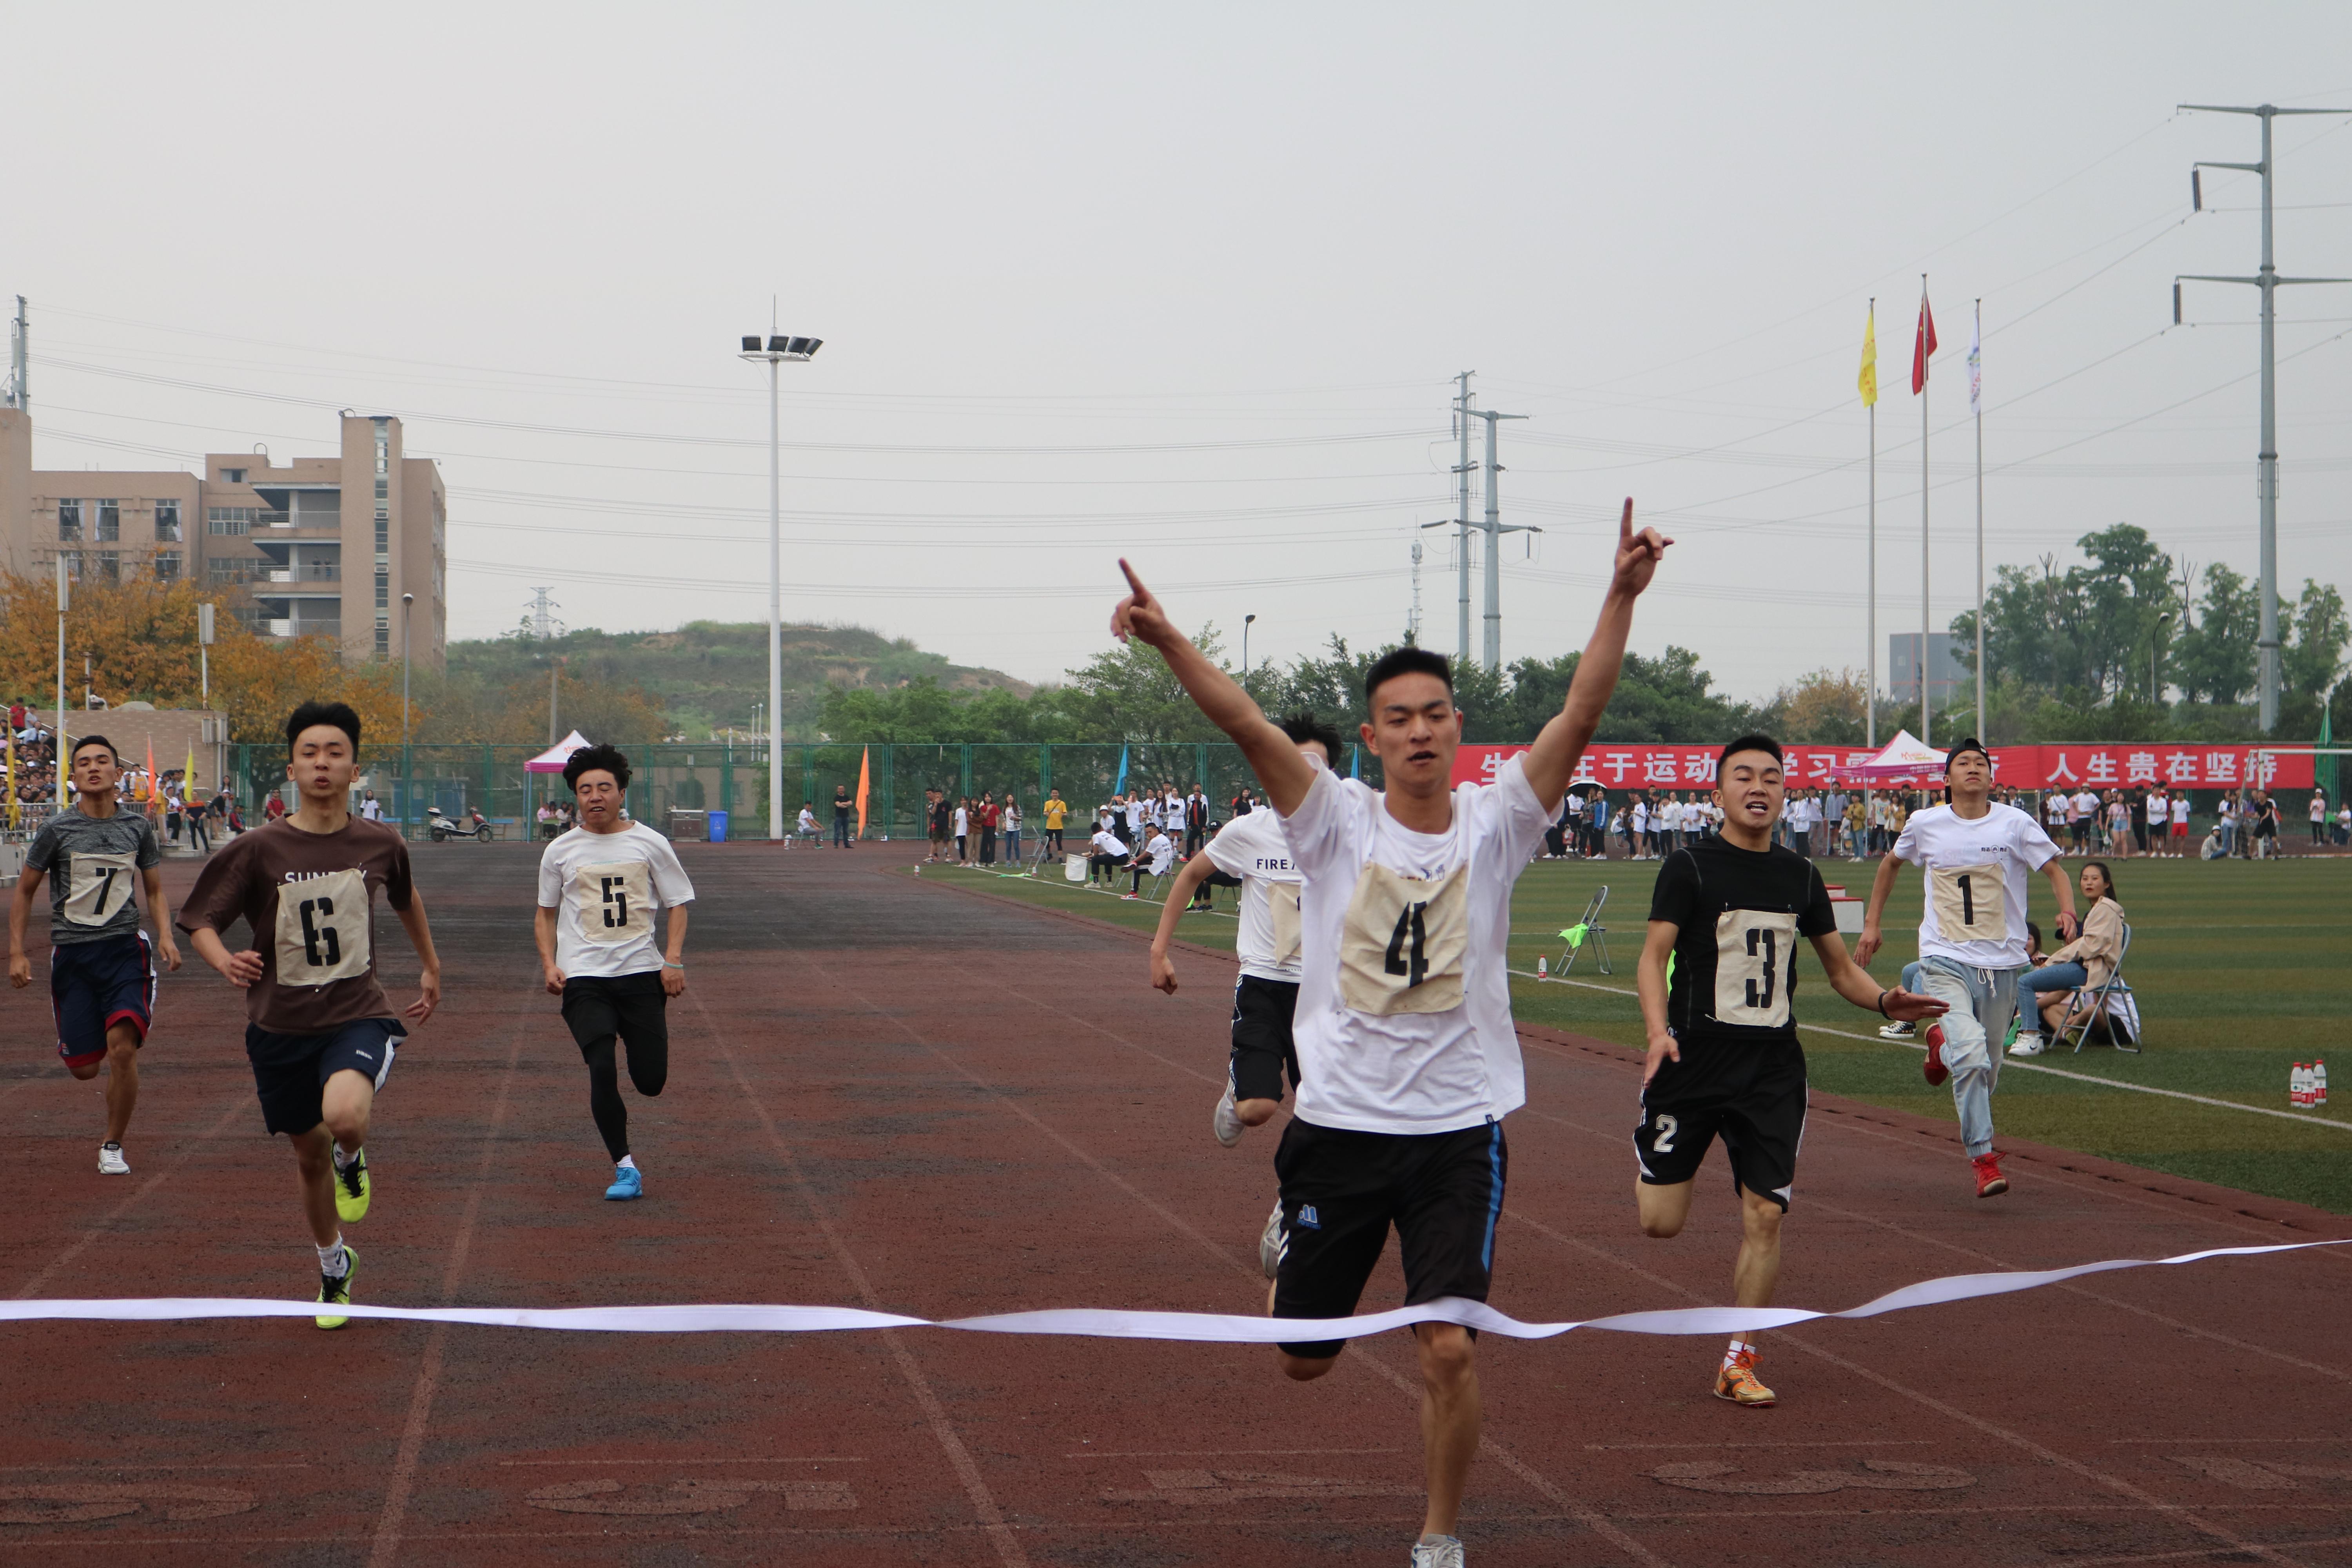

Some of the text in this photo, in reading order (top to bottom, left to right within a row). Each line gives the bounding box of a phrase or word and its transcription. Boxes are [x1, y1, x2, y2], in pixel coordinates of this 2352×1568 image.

[1480, 751, 1717, 783] 生在于运动
[2046, 751, 2277, 784] 人生贵在坚持
[1256, 858, 1288, 870] FIRE
[93, 867, 118, 915] 7
[601, 877, 627, 927] 5
[1957, 874, 1974, 926] 1
[299, 897, 341, 967] 6
[1385, 901, 1429, 989] 4
[1745, 928, 1776, 1009] 3
[1653, 1113, 1678, 1153] 2
